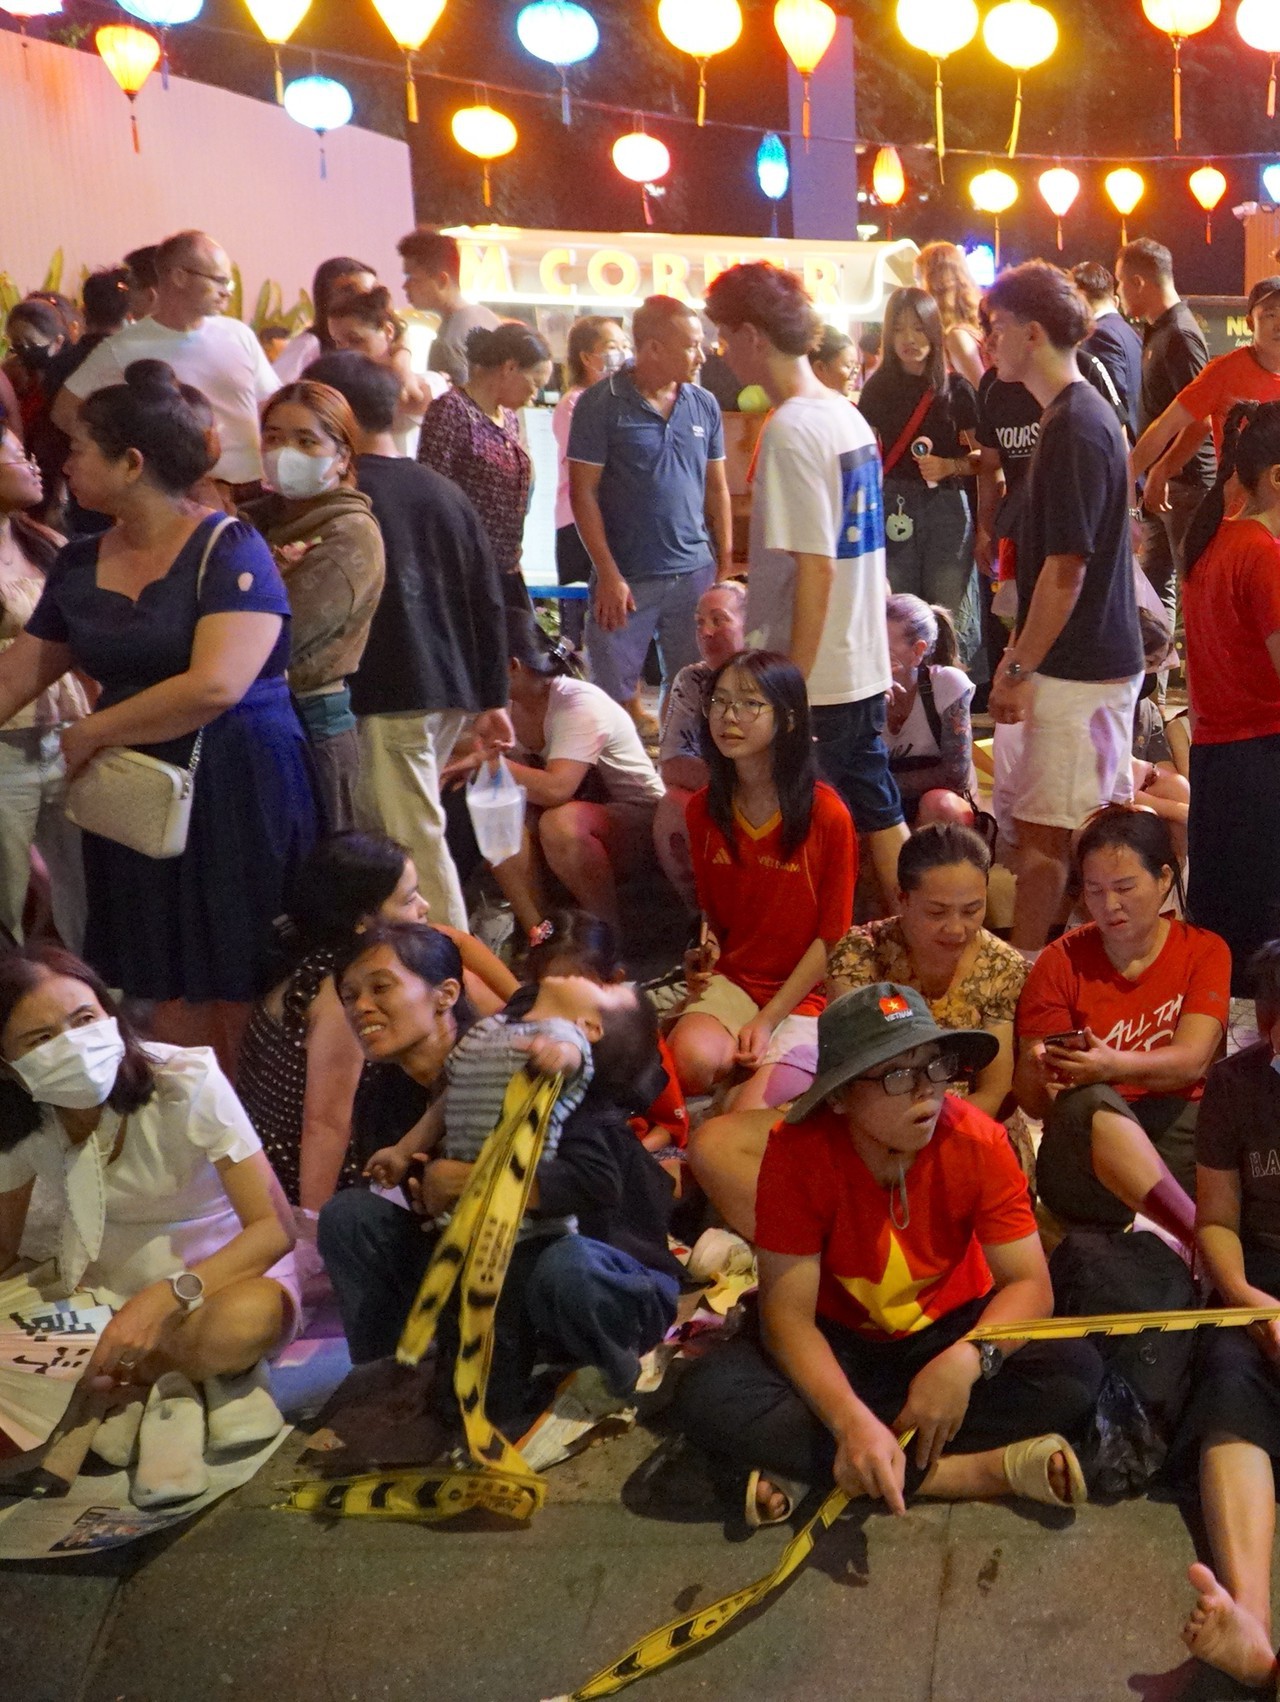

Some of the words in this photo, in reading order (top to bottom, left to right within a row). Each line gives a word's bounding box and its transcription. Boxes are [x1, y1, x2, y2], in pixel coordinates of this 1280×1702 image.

[539, 249, 842, 305] CORR
[995, 422, 1041, 449] YOURS
[1102, 1010, 1152, 1052] ALL
